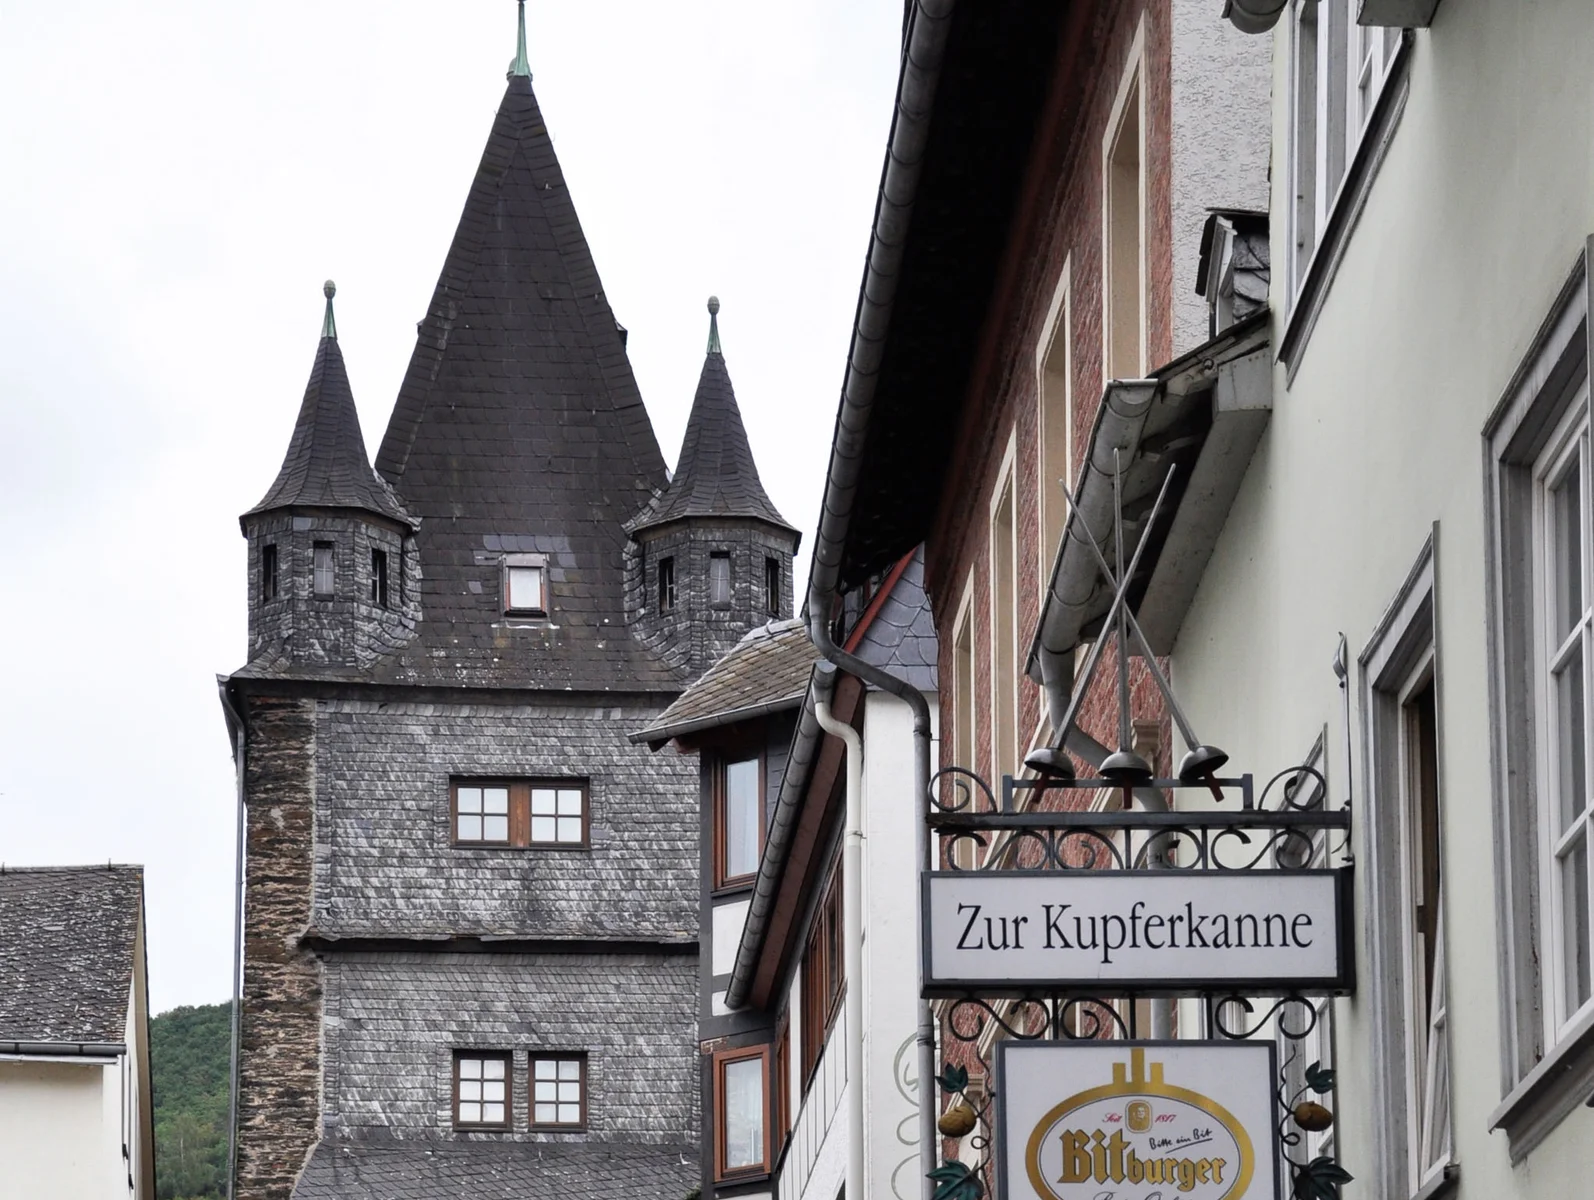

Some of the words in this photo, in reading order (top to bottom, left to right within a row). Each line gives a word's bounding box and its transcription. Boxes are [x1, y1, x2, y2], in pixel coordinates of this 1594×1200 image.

[956, 902, 1028, 950] Zur
[1041, 901, 1313, 963] Kupferkanne
[1102, 1112, 1122, 1123] Seit
[1154, 1114, 1177, 1123] 1817
[1057, 1128, 1227, 1192] Bitburger
[1149, 1136, 1173, 1150] Bitte
[1193, 1128, 1213, 1140] Bit
